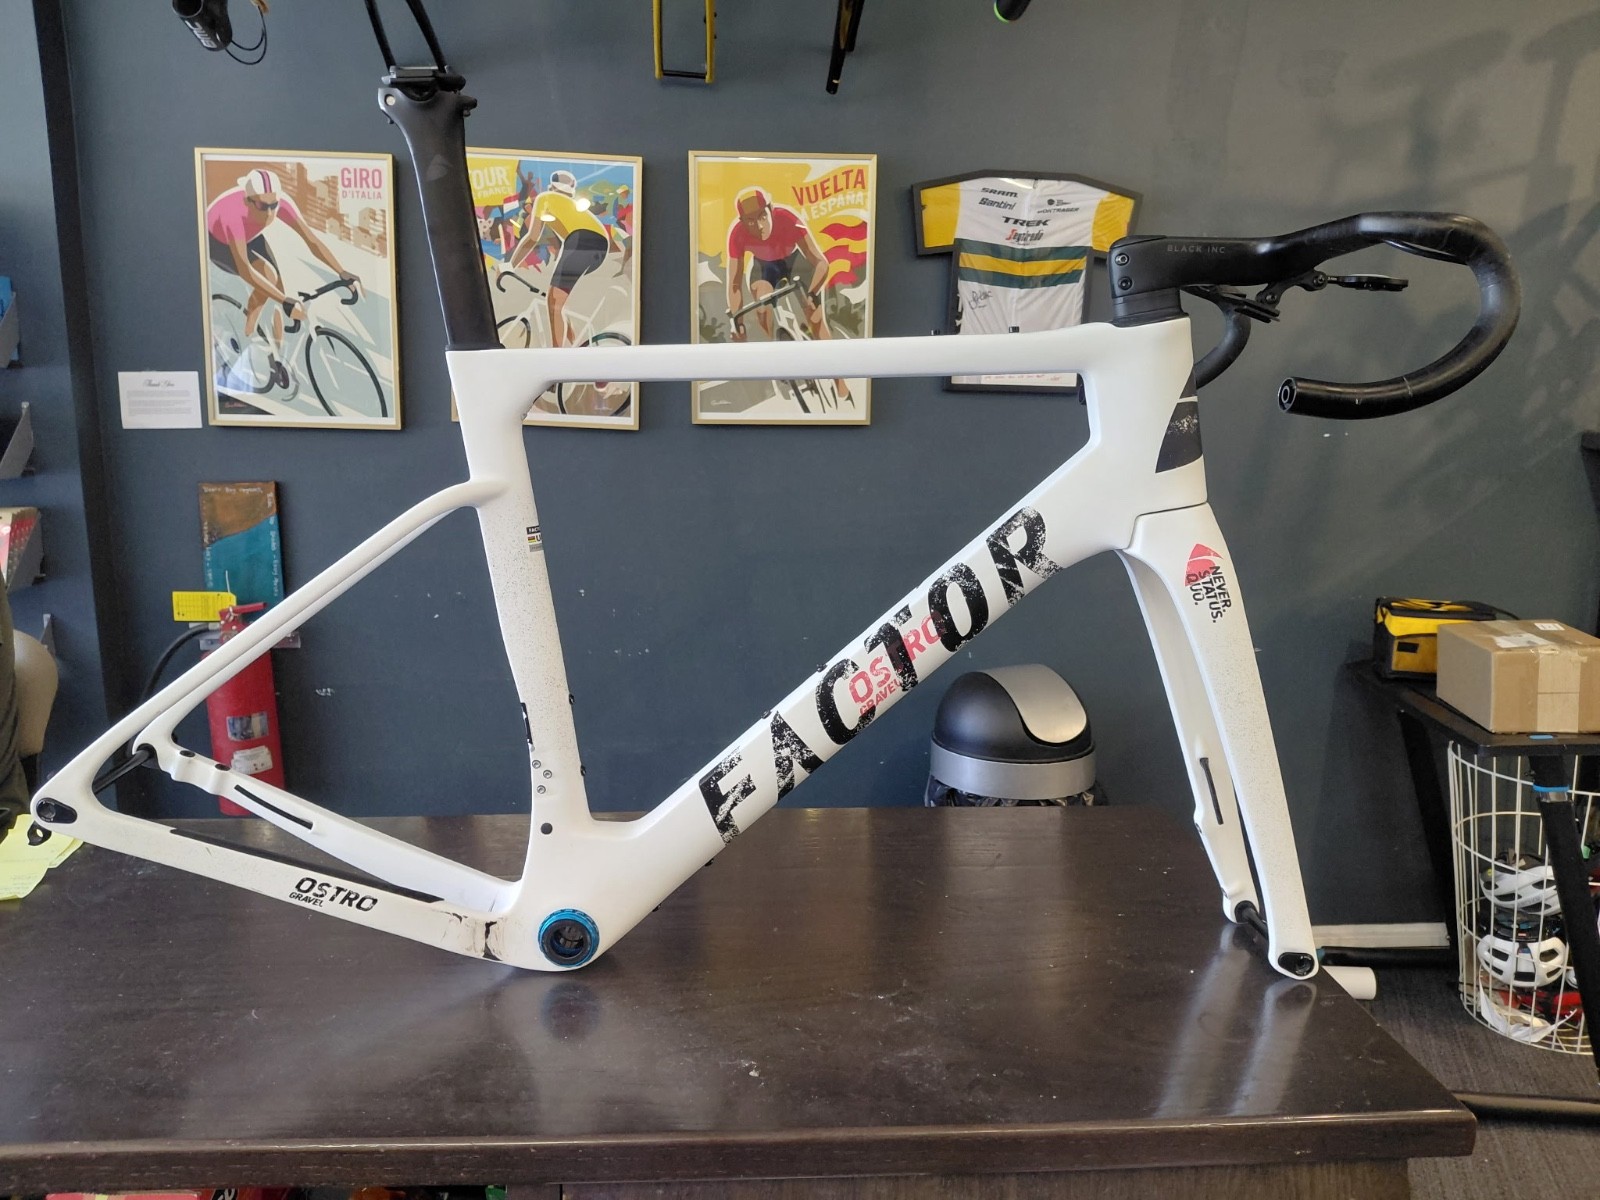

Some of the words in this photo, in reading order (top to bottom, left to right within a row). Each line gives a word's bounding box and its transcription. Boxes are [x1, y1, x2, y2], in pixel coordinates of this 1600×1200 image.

[341, 167, 382, 189] GIRO
[468, 166, 511, 190] OUR
[792, 168, 866, 206] VUELTA
[342, 190, 382, 200] D'ITALIA
[979, 197, 1017, 210] Santini
[981, 187, 1018, 198] SRAM
[1002, 216, 1051, 227] TREK
[1167, 244, 1202, 253] BLACK
[1207, 246, 1226, 254] INC
[1186, 573, 1205, 605] QUO.
[1198, 570, 1223, 623] STATUS.
[1209, 566, 1232, 612] NEVER.
[699, 504, 1064, 846] FACTOR
[289, 892, 324, 907] GRAVEL
[295, 877, 378, 911] OSTRO
